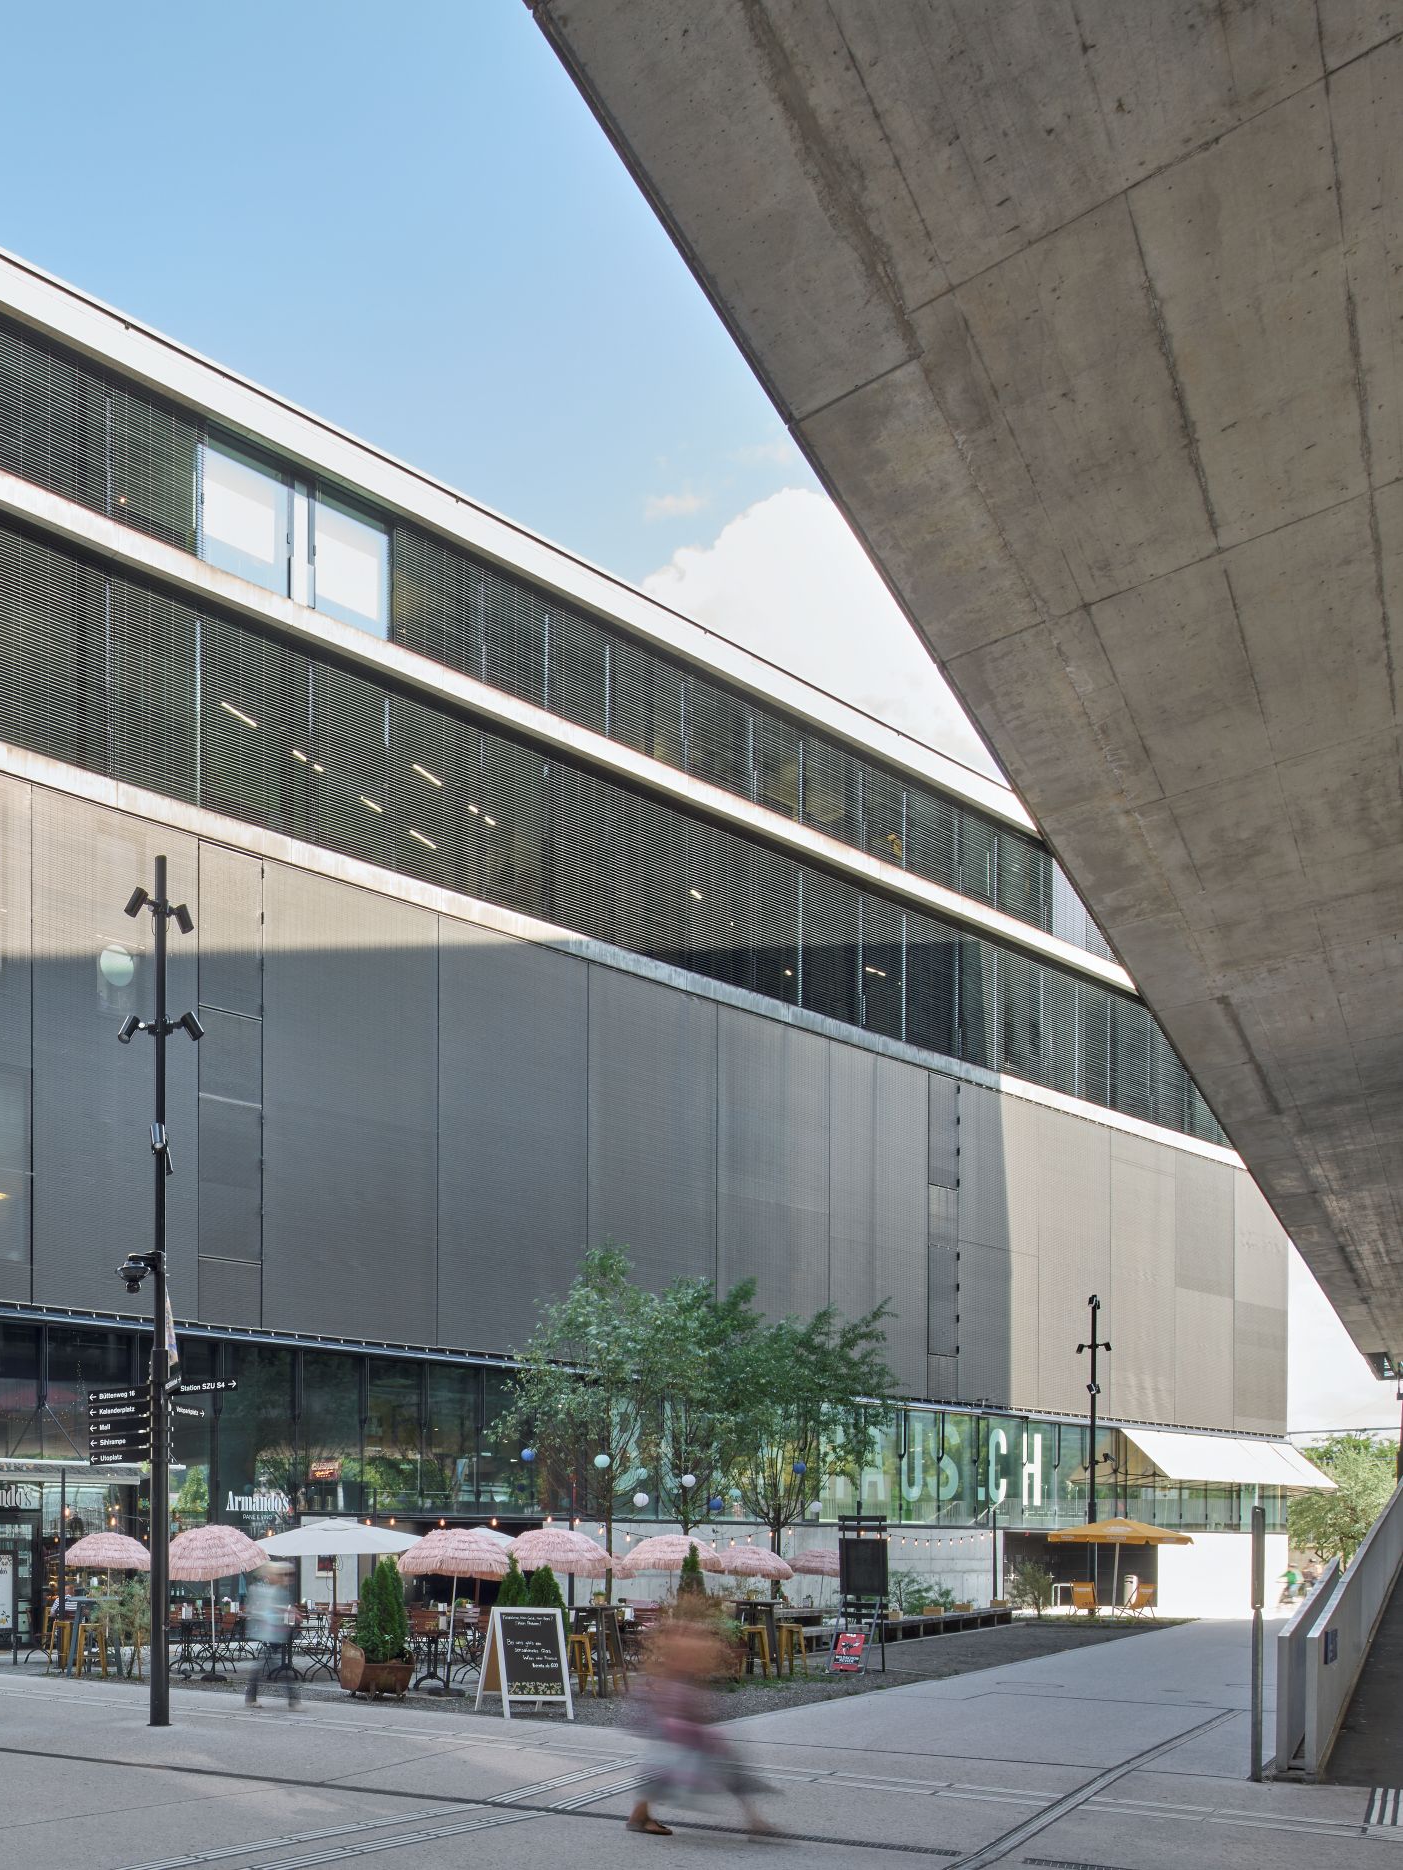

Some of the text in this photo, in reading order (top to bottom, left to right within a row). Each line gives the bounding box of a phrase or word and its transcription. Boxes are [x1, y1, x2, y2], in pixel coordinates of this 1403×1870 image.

[99, 1391, 127, 1399] Büttenweg
[99, 1406, 135, 1415] Kalanderplatz
[100, 1454, 122, 1462] Utoplatz
[226, 1491, 290, 1512] Armando's
